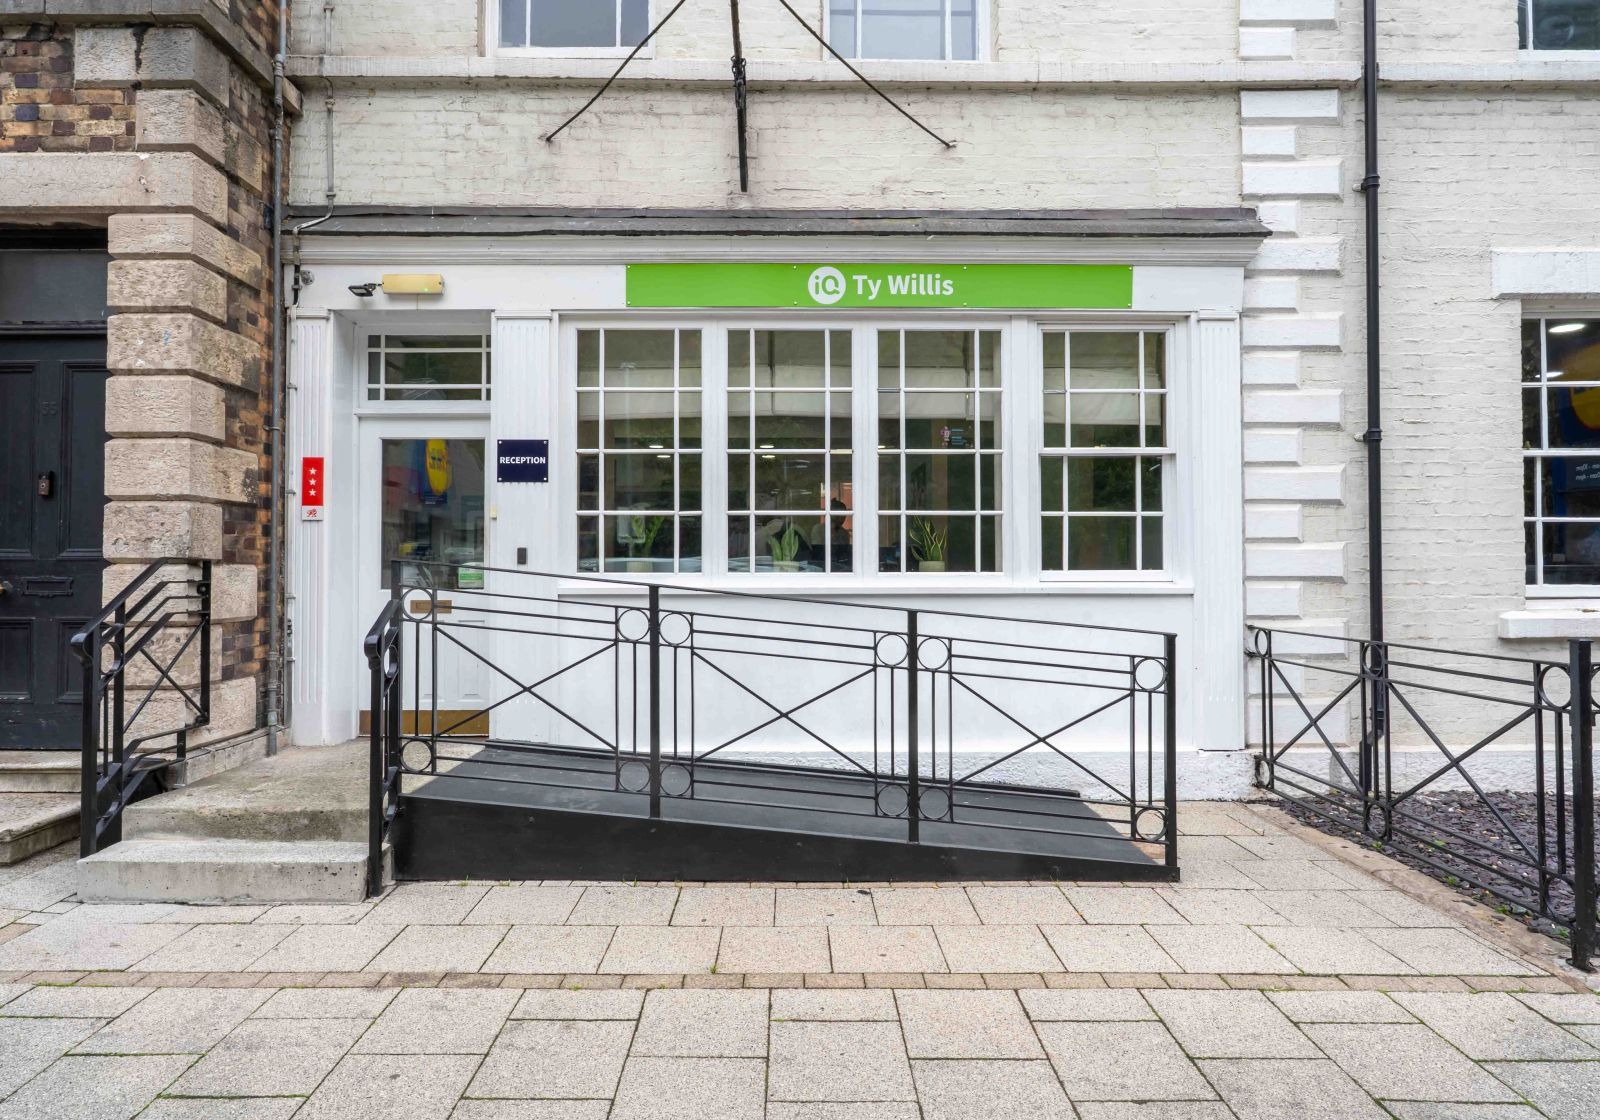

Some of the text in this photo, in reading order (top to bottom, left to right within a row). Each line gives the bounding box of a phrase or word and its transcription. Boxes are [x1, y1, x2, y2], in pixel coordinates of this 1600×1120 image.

[852, 274, 882, 301] Ty
[887, 272, 954, 296] Willis
[499, 456, 546, 464] RECEPTION
